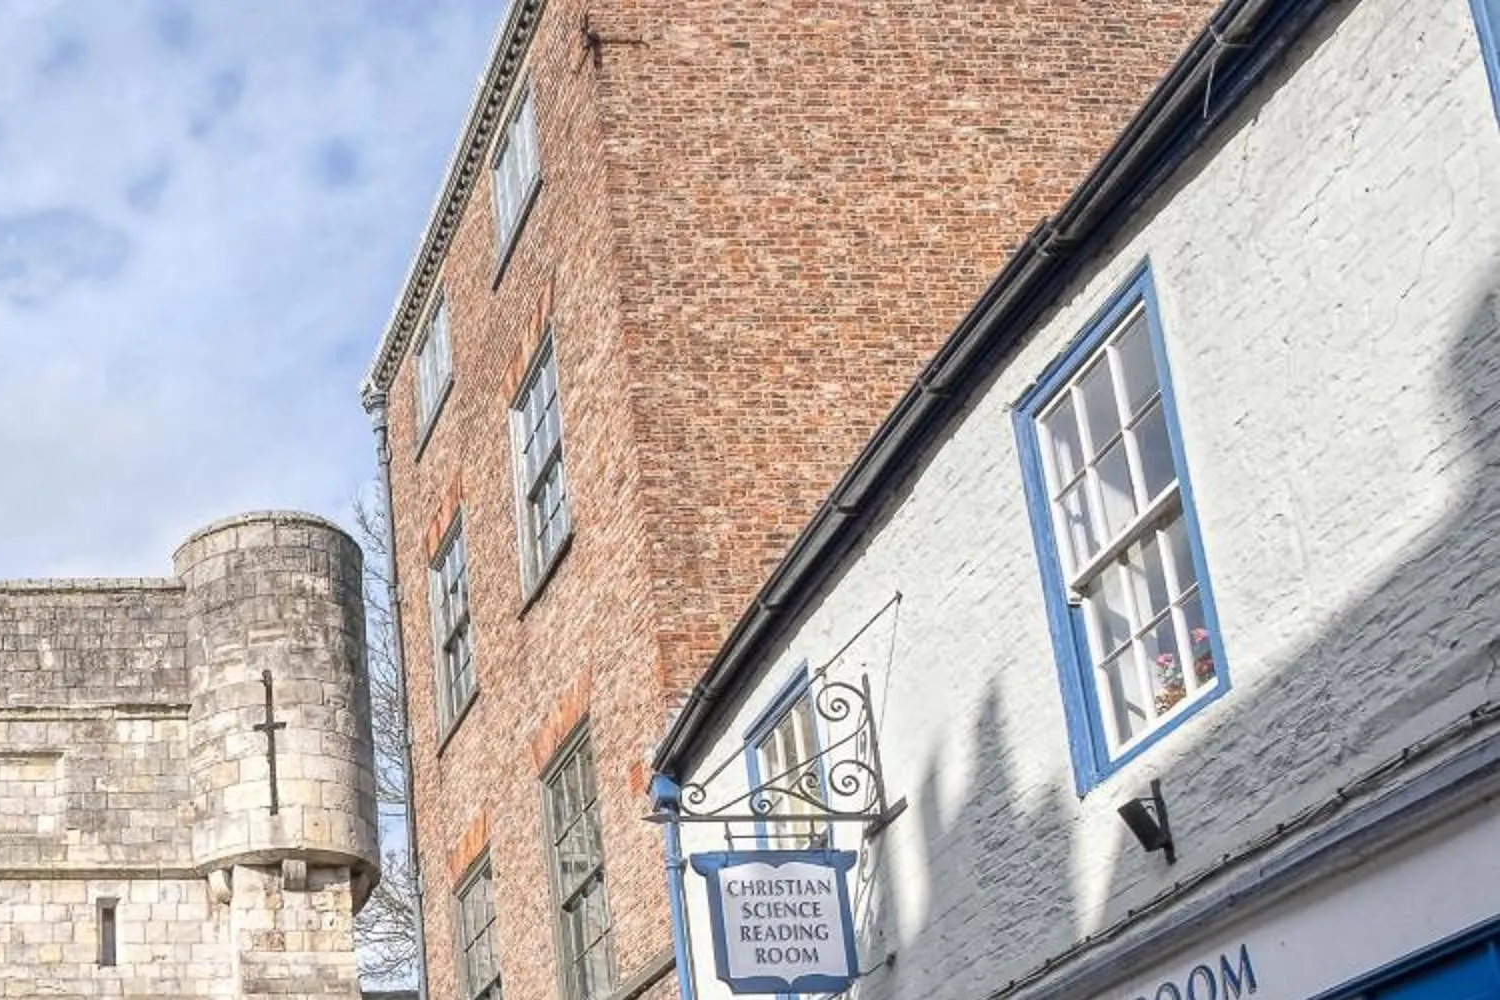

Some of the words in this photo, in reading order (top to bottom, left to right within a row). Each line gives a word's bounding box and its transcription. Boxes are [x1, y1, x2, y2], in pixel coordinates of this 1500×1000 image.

[726, 880, 831, 897] CHRISTIAN
[742, 901, 822, 919] SCIENCE
[740, 924, 829, 942] READING
[755, 947, 819, 964] ROOM
